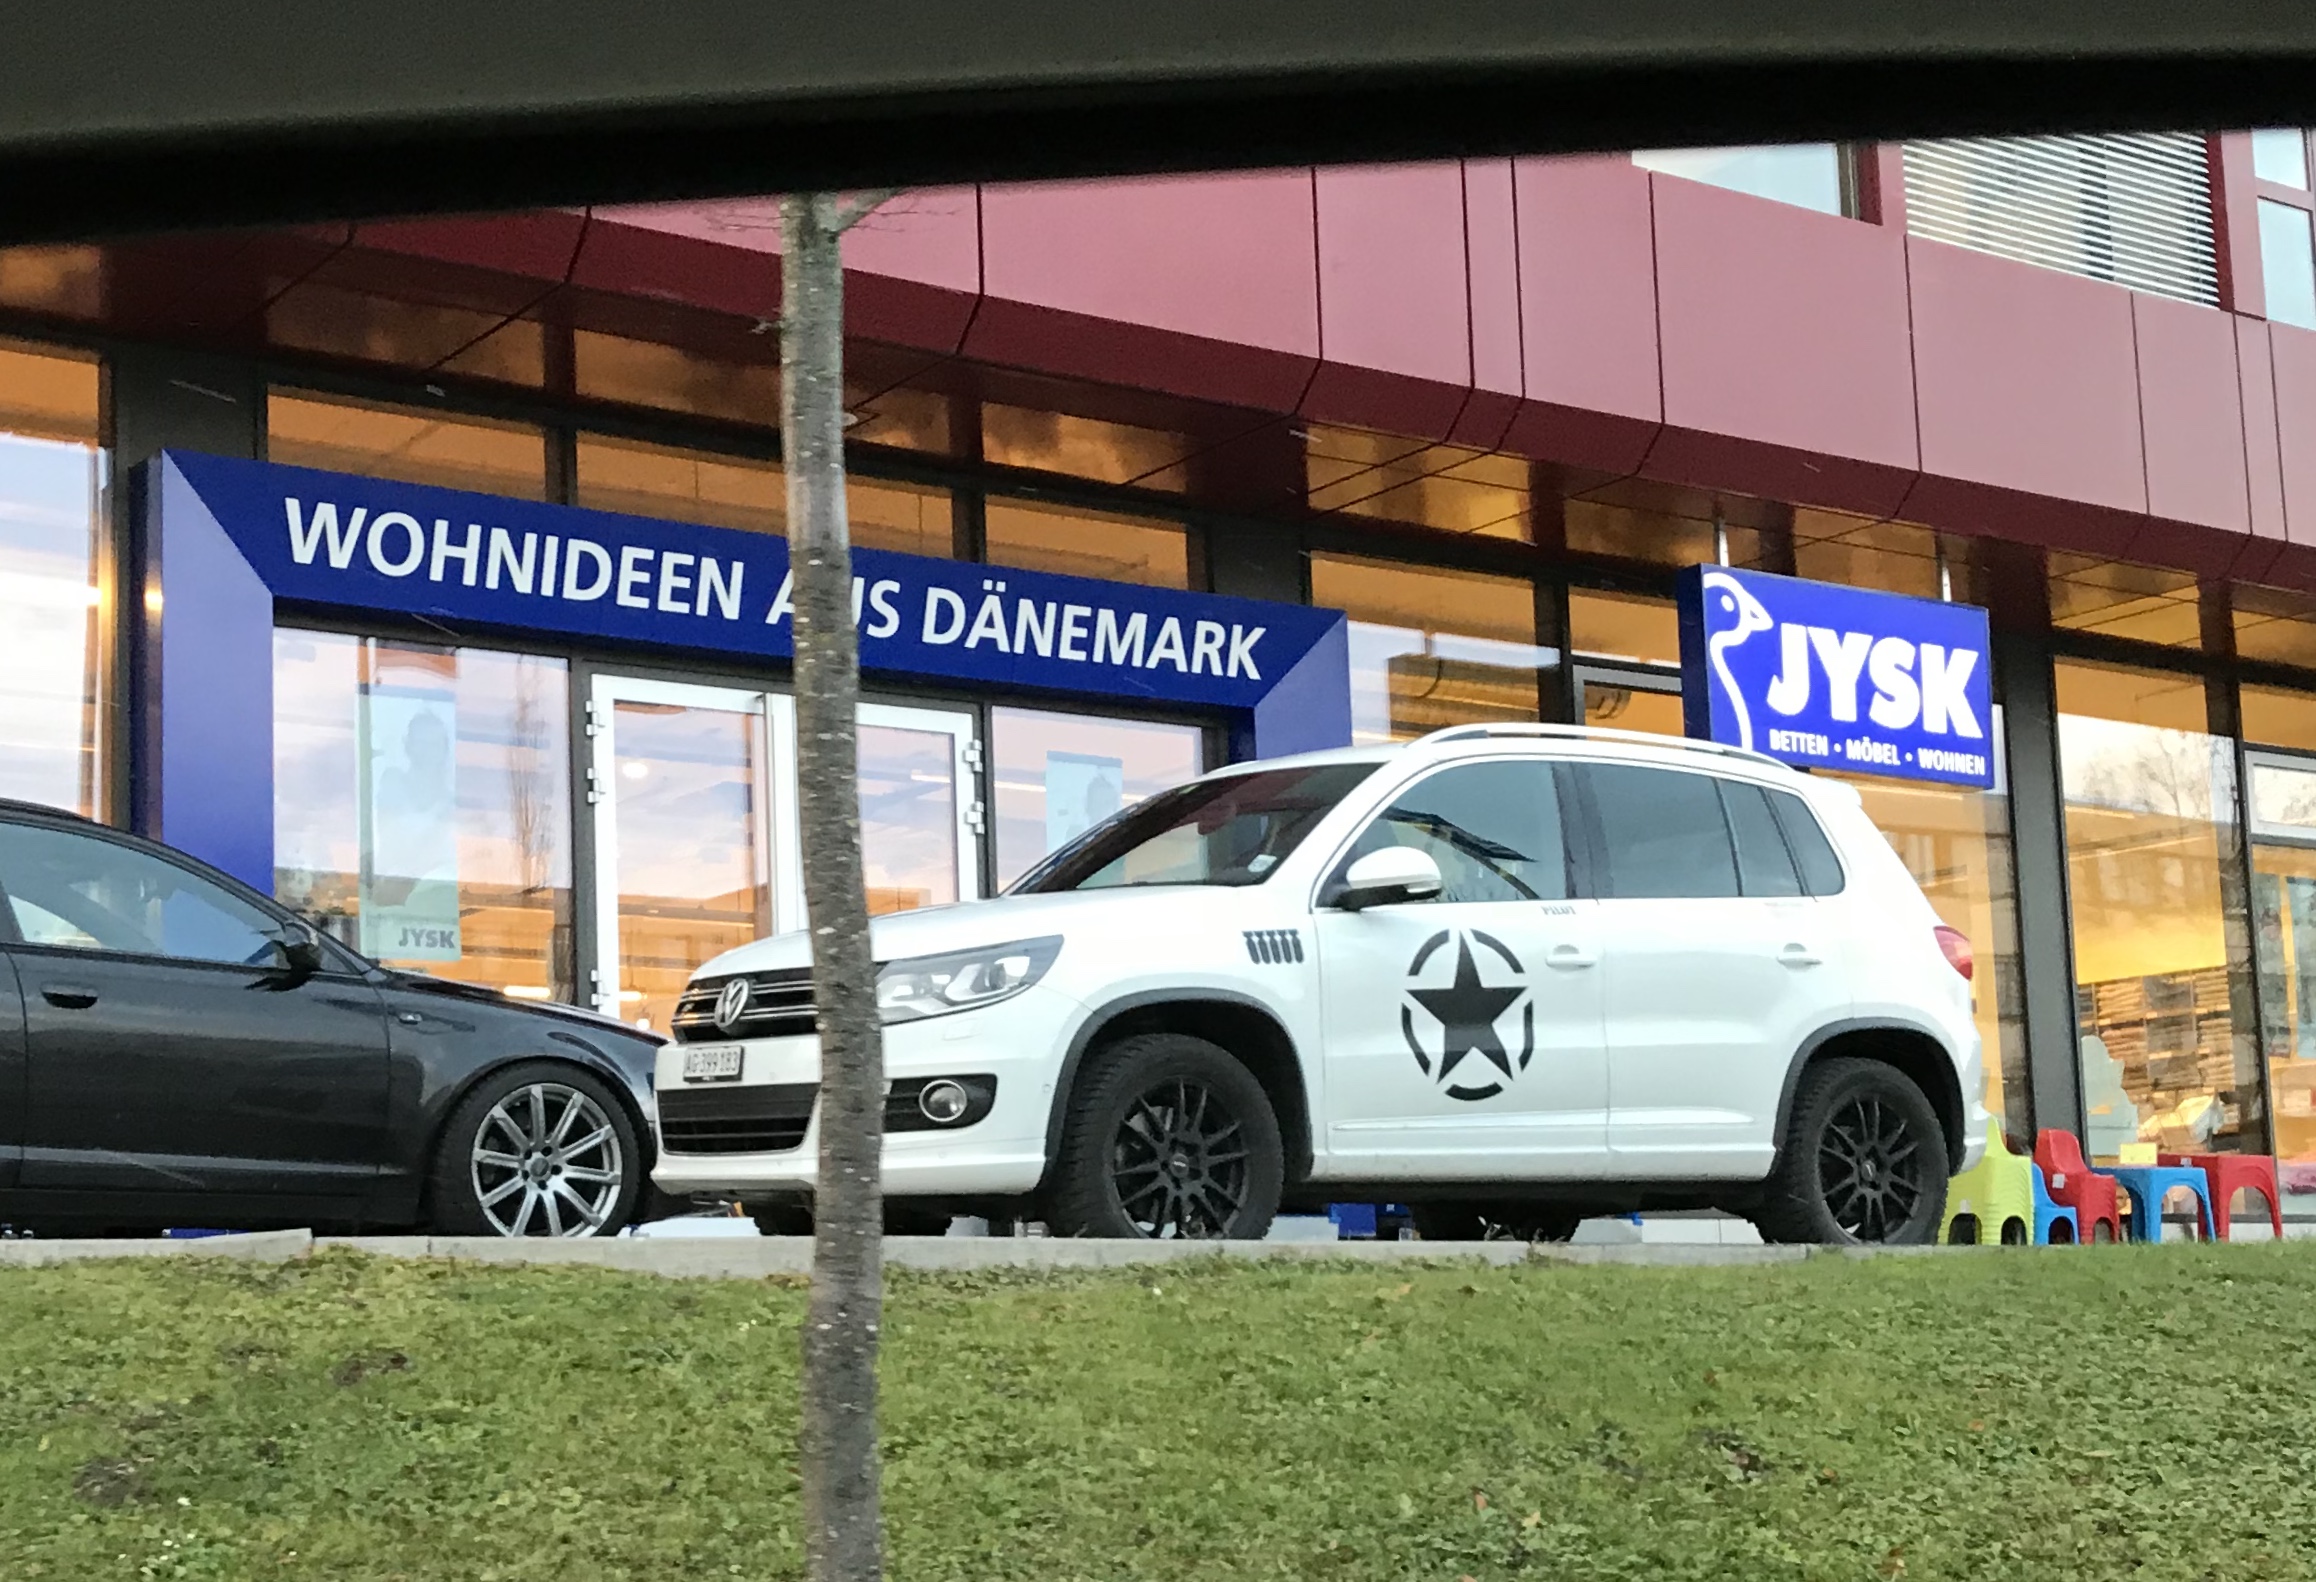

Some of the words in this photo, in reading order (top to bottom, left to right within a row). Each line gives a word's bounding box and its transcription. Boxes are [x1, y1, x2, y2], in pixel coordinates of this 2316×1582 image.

[285, 497, 744, 620] WOHNIDEEN
[922, 579, 1266, 680] DÄNEMARK
[1766, 622, 1984, 739] JYSK
[1769, 728, 1829, 757] BETTEN
[1845, 736, 1901, 766] MÖBEL
[1917, 747, 1986, 776] WOHNEN
[398, 926, 455, 949] JYSK
